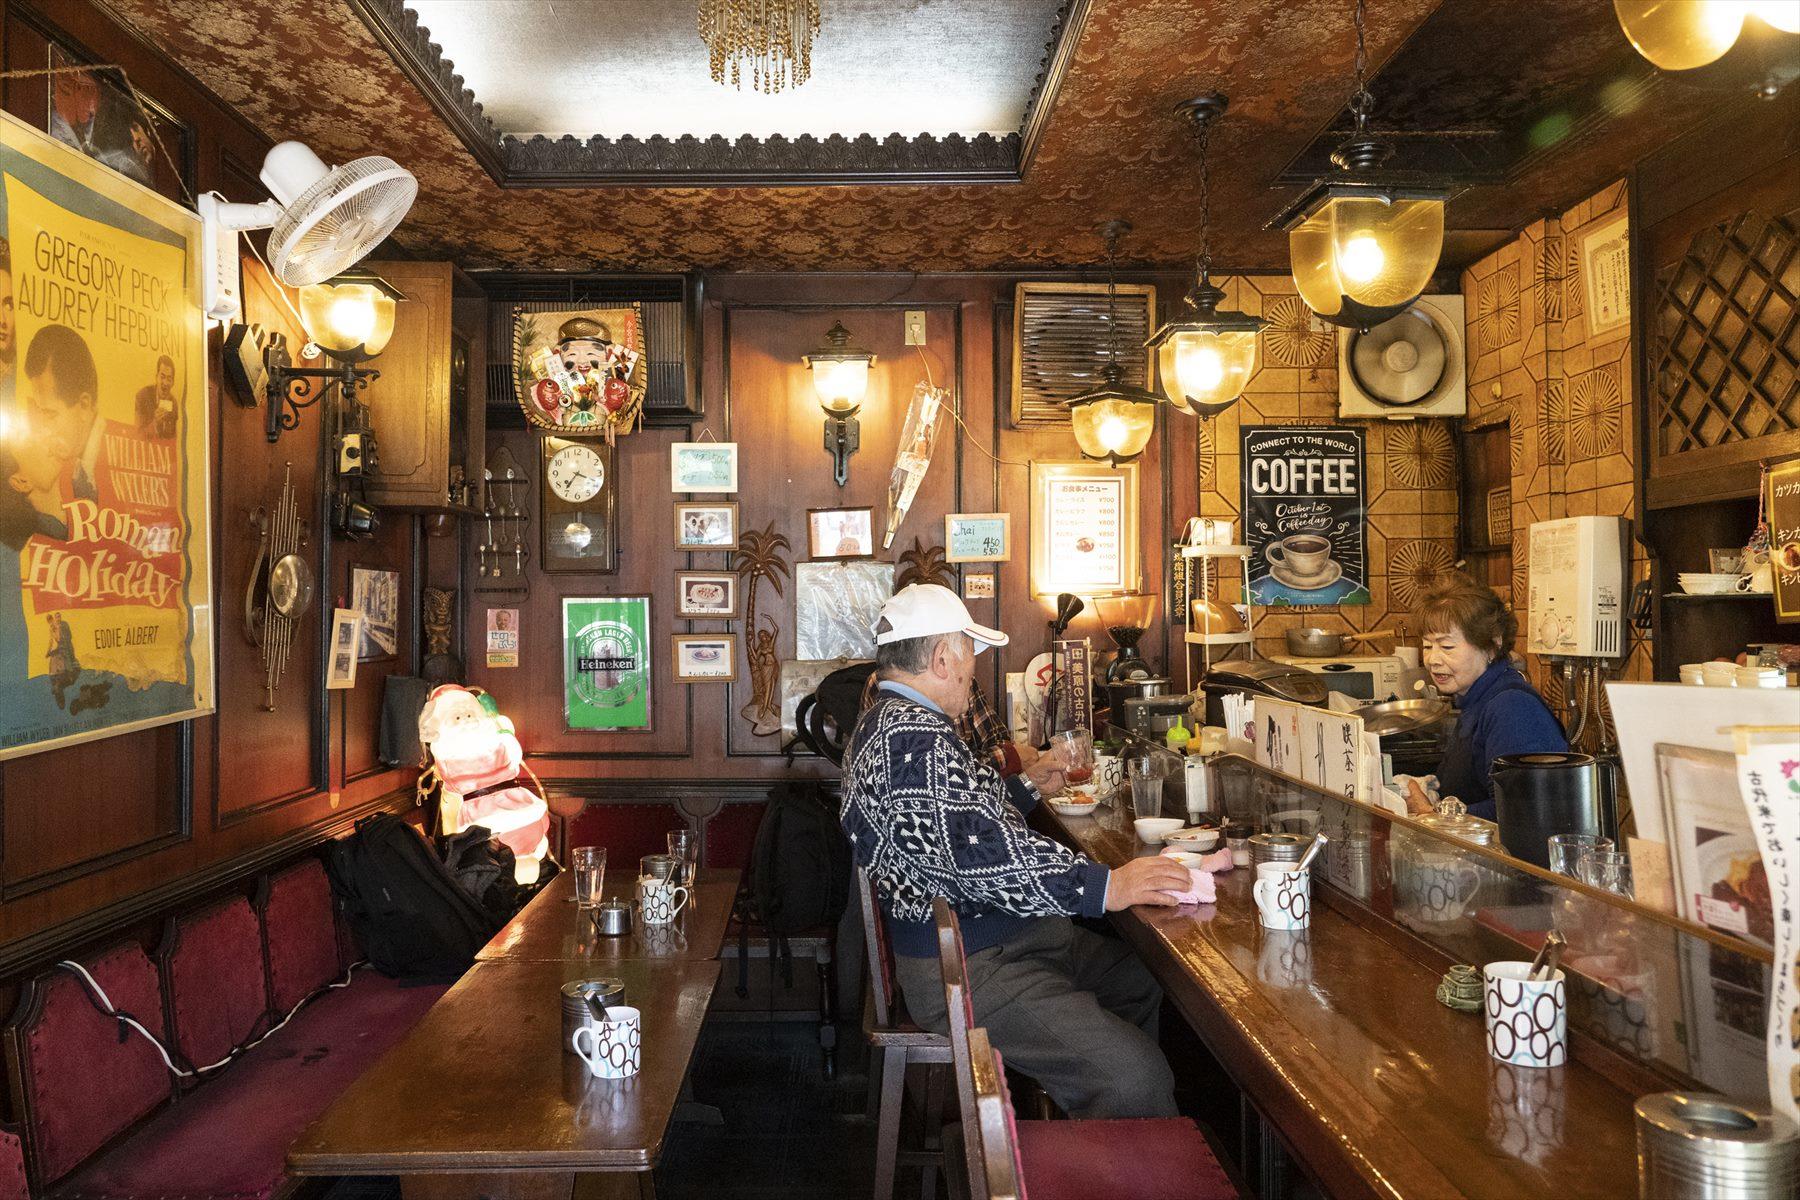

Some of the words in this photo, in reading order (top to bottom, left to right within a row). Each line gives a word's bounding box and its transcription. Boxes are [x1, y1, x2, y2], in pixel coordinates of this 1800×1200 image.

[35, 230, 125, 299] GREGORY
[132, 268, 170, 316] PECK
[18, 272, 99, 333] AUDREY
[105, 300, 180, 358] HEPBURN
[105, 434, 171, 475] WILLIAM
[1250, 437, 1290, 453] CONNECT
[1292, 436, 1304, 444] TO
[1307, 436, 1322, 445] THE
[1325, 438, 1356, 453] WORLD
[1251, 458, 1357, 494] COFFEE
[62, 499, 181, 559] Roman
[22, 543, 181, 607] Holiday
[94, 629, 121, 649] EDDIE
[124, 625, 159, 647] ALBERT
[580, 659, 634, 670] Heineken
